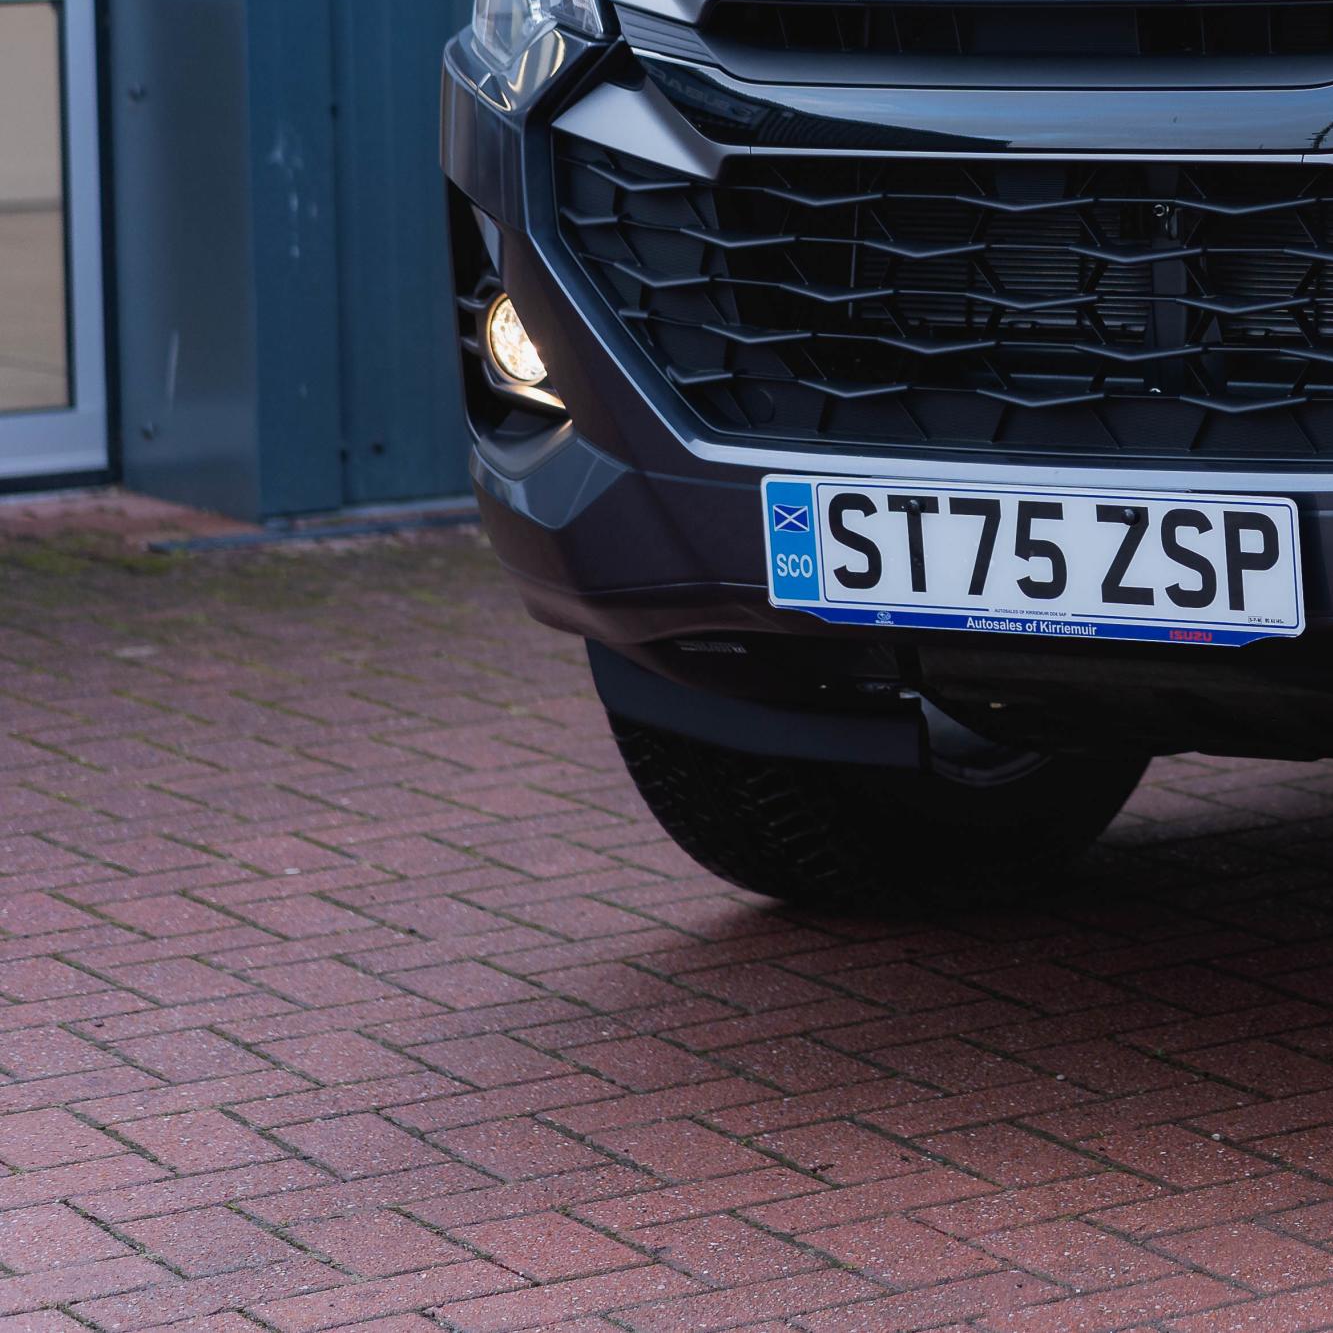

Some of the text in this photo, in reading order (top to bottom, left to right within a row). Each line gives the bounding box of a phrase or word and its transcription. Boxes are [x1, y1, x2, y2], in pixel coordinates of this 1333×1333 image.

[828, 492, 1281, 611] ST75 ZSP
[776, 553, 813, 578] SCO
[966, 616, 1098, 636] Autosales of Kirriemuir
[1168, 629, 1213, 643] ISUZU
